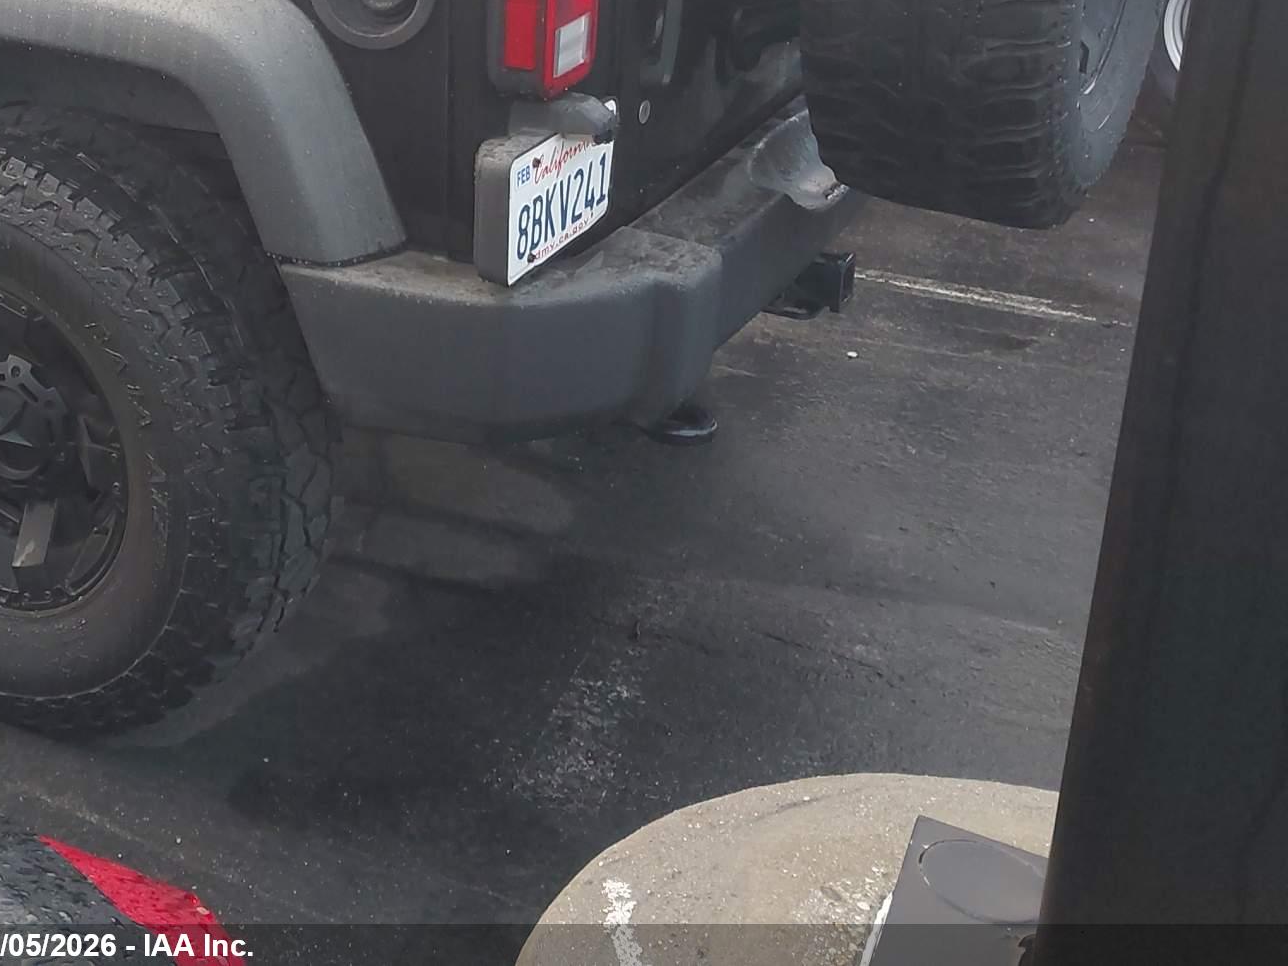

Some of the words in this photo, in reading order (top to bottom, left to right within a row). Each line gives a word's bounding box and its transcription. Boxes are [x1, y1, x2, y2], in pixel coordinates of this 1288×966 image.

[516, 165, 531, 187] FEB
[516, 152, 607, 261] 8BKV241
[534, 218, 589, 261] dmv.ca.gov
